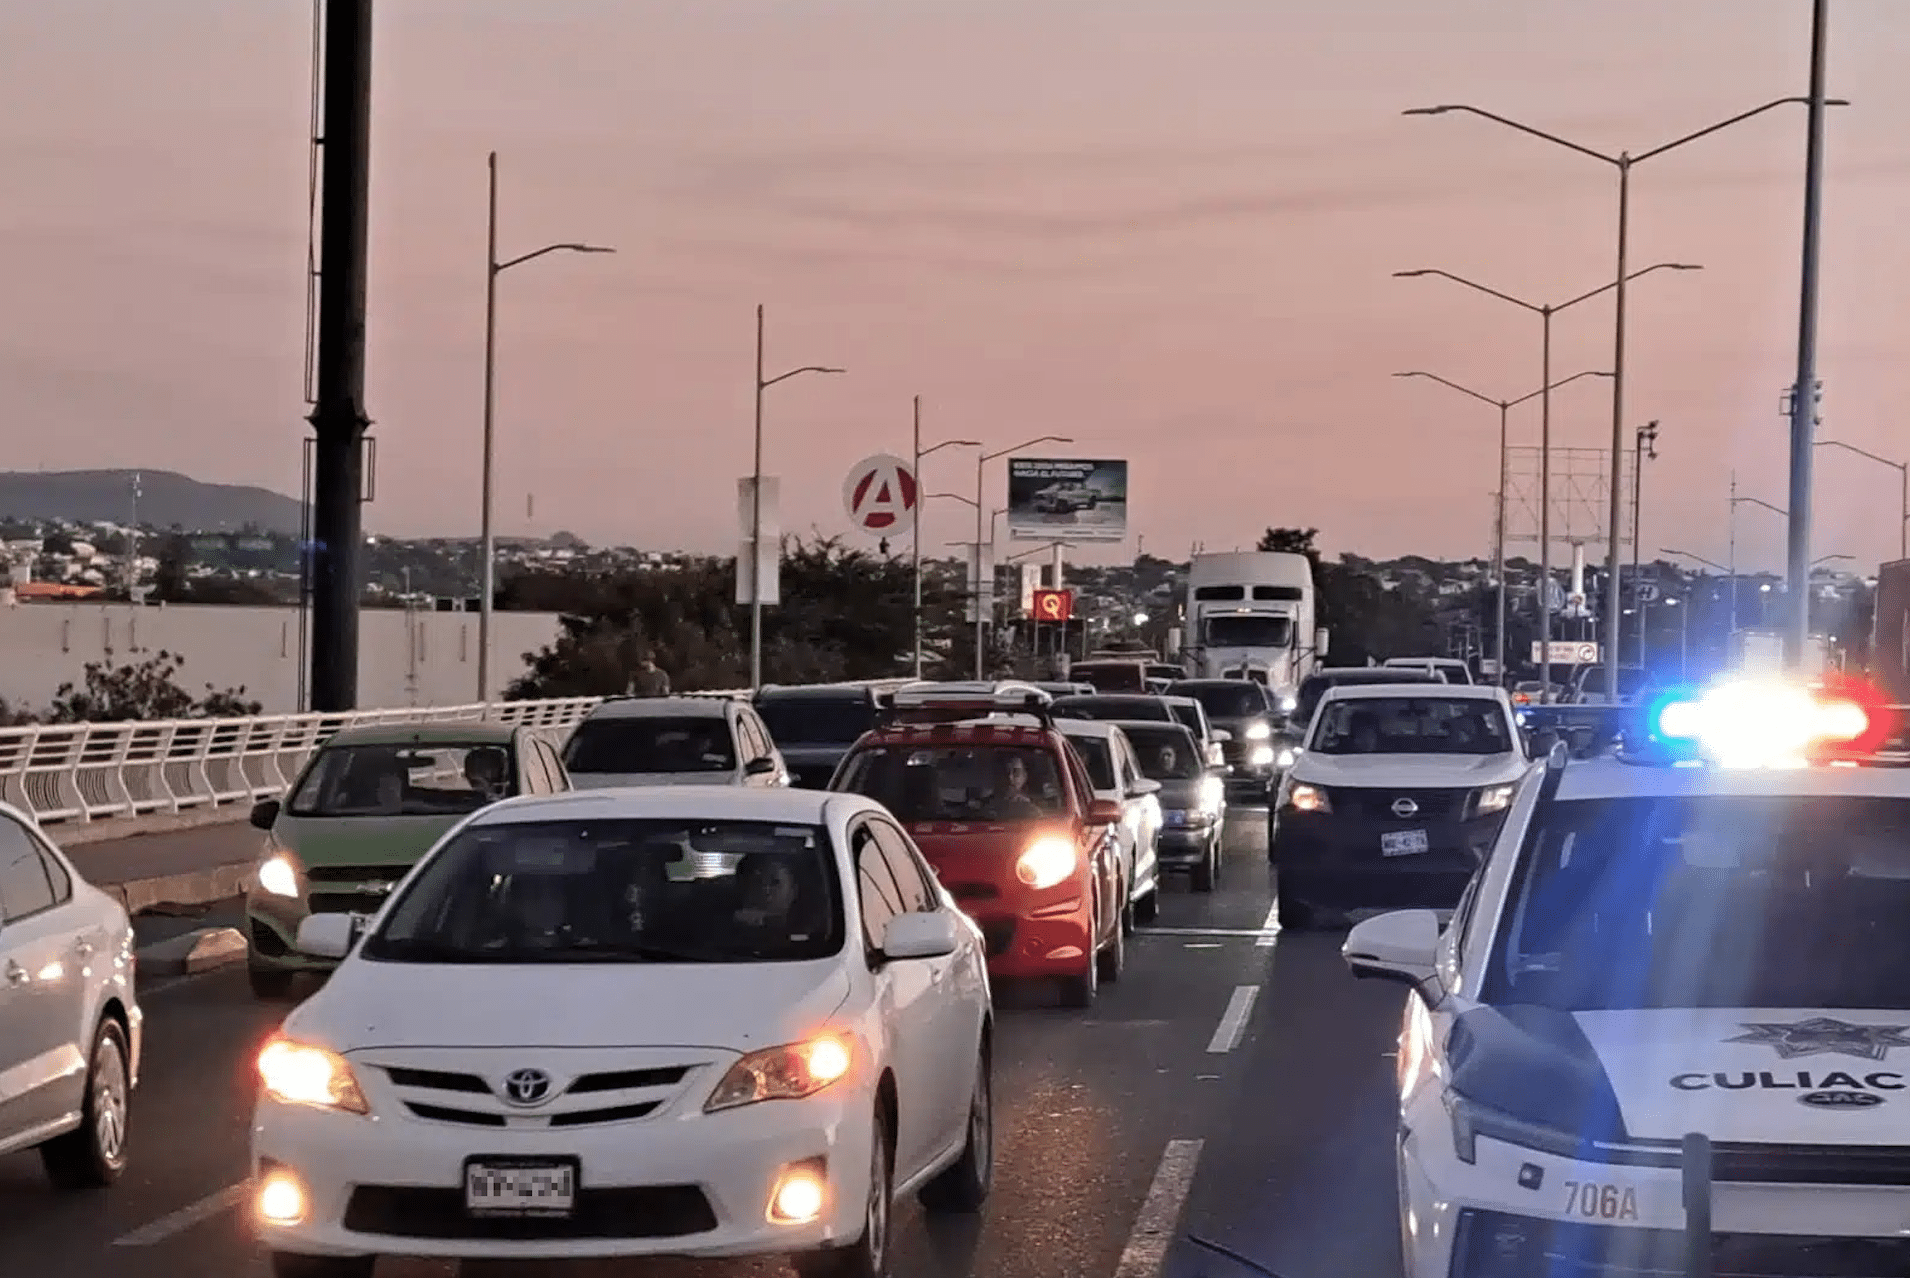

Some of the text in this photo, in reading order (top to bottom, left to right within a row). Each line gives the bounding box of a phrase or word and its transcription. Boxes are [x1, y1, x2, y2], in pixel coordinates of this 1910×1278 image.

[850, 464, 916, 530] A
[1669, 1071, 1907, 1091] CULIAC
[1564, 1181, 1639, 1221] 706A
